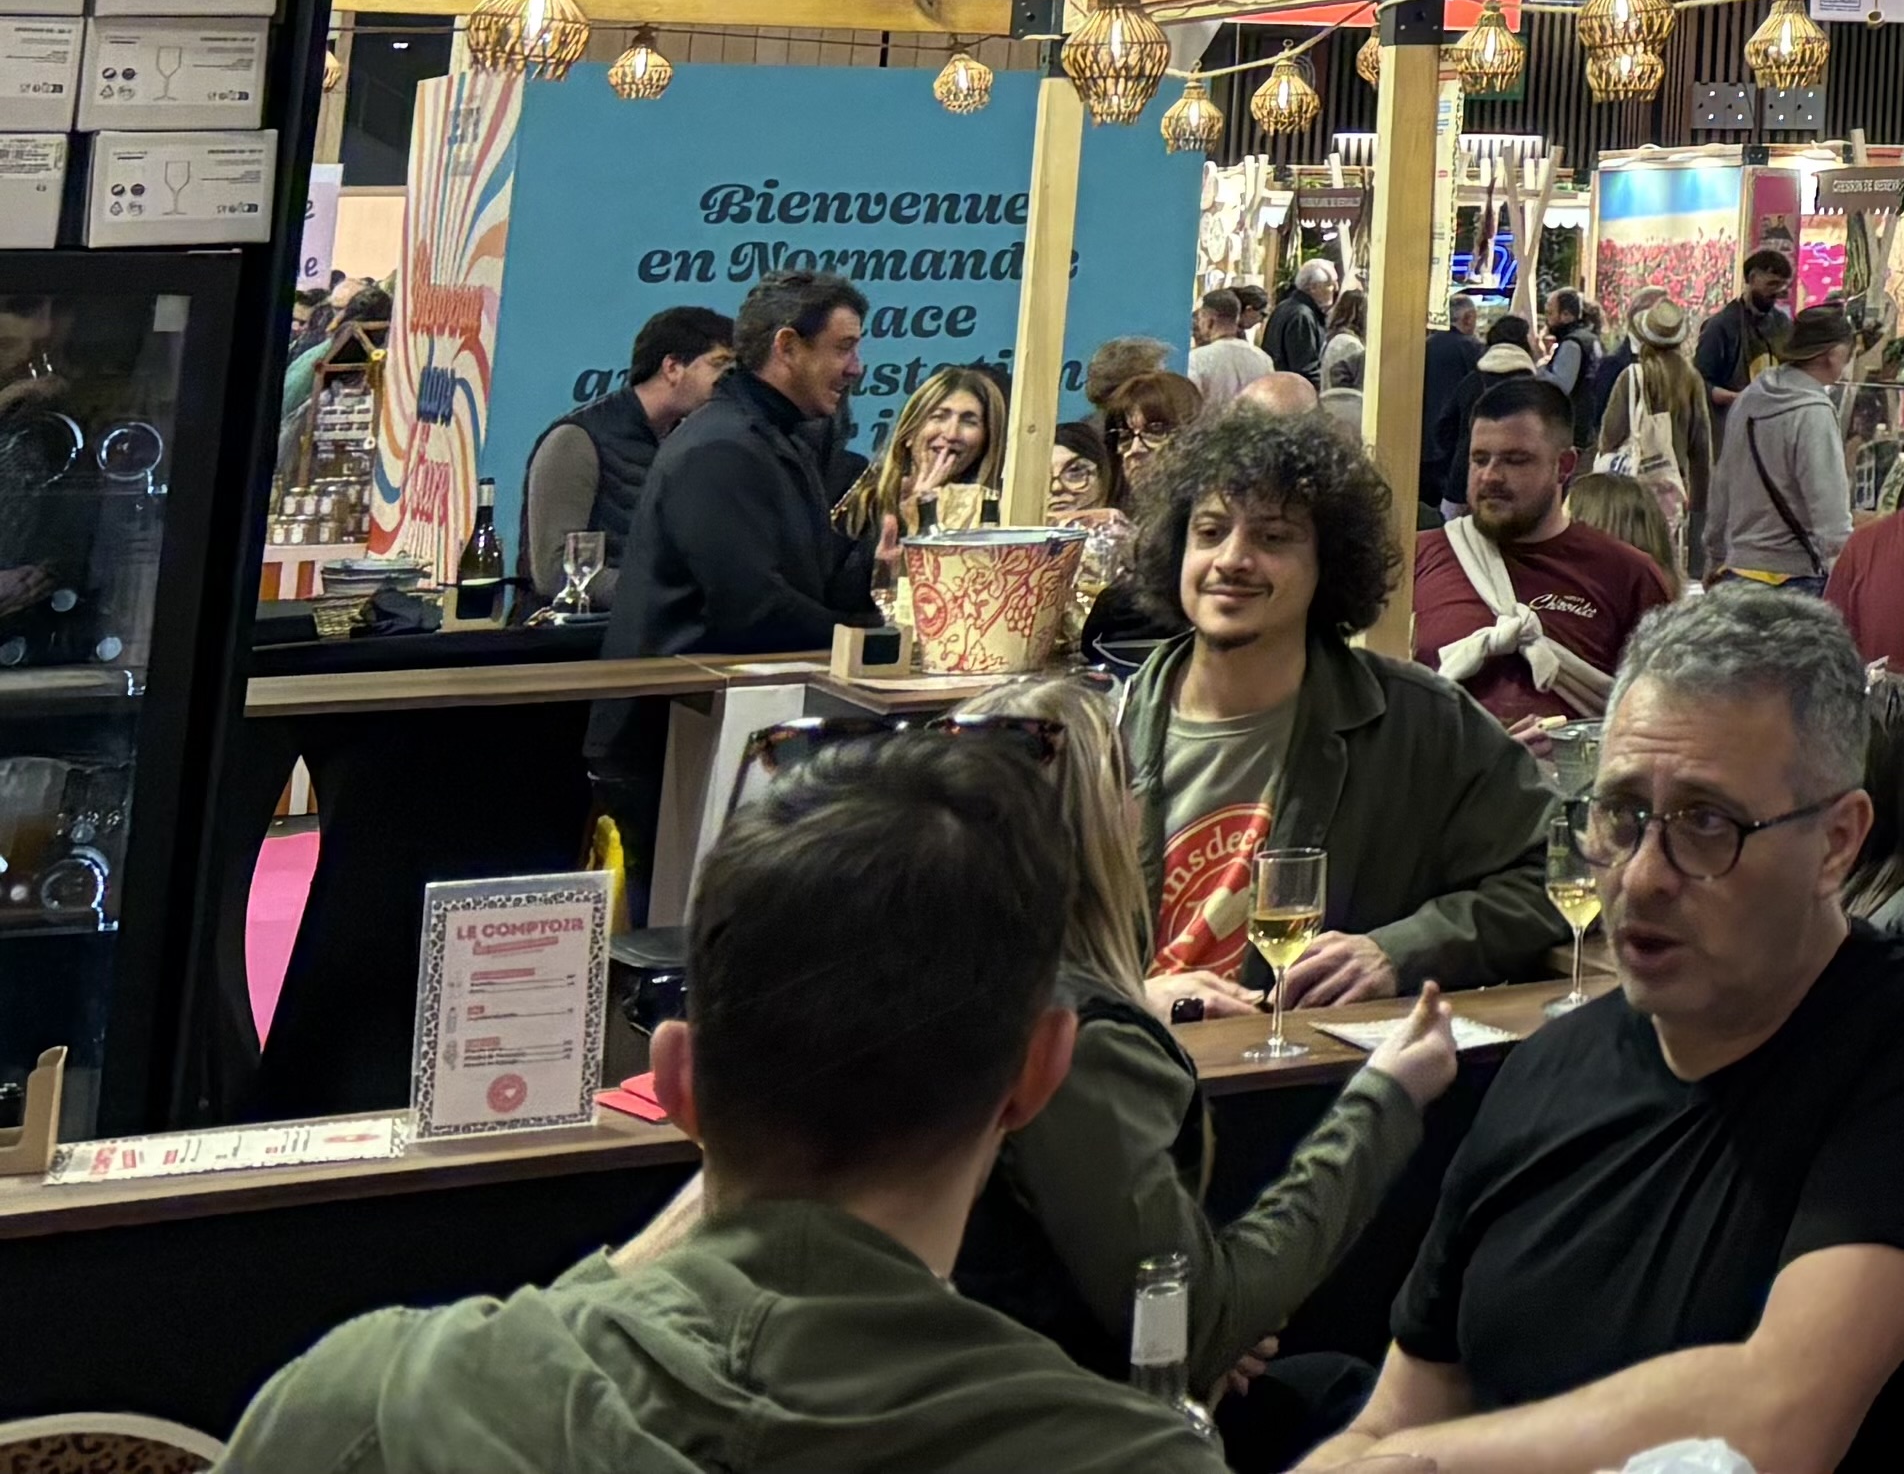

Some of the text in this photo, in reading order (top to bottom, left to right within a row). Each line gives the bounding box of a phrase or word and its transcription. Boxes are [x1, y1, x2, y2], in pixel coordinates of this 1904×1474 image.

[699, 178, 1030, 226] Bienvenue
[637, 248, 716, 285] en
[457, 924, 478, 942] LE
